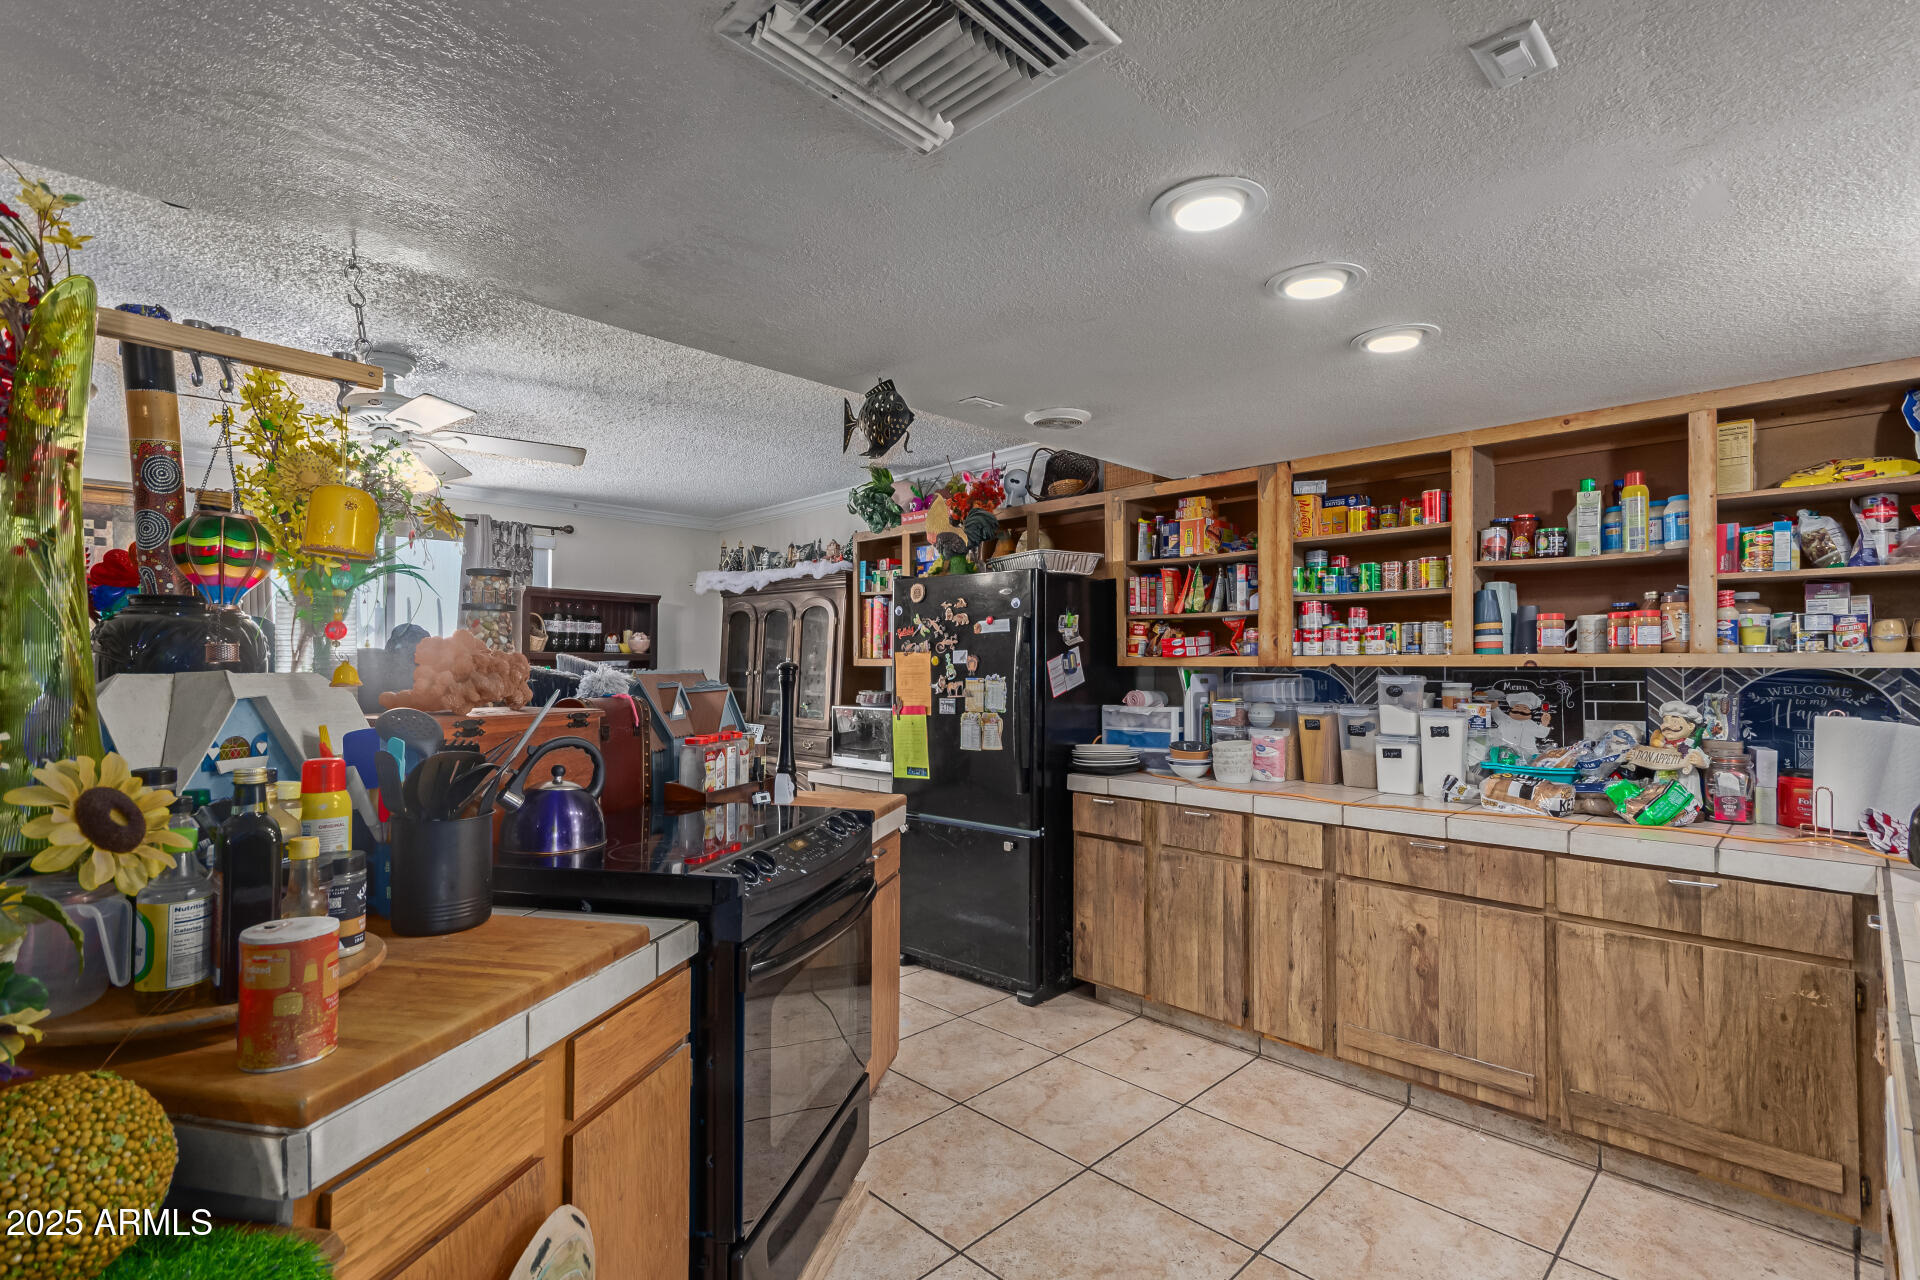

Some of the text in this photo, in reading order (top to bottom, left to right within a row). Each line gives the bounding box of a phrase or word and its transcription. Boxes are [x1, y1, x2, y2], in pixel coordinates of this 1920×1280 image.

[1502, 681, 1529, 691] Menu
[1767, 685, 1853, 697] WELCOME
[1795, 698, 1828, 708] to my
[1635, 749, 1655, 761] BON
[174, 902, 208, 913] Nutrition
